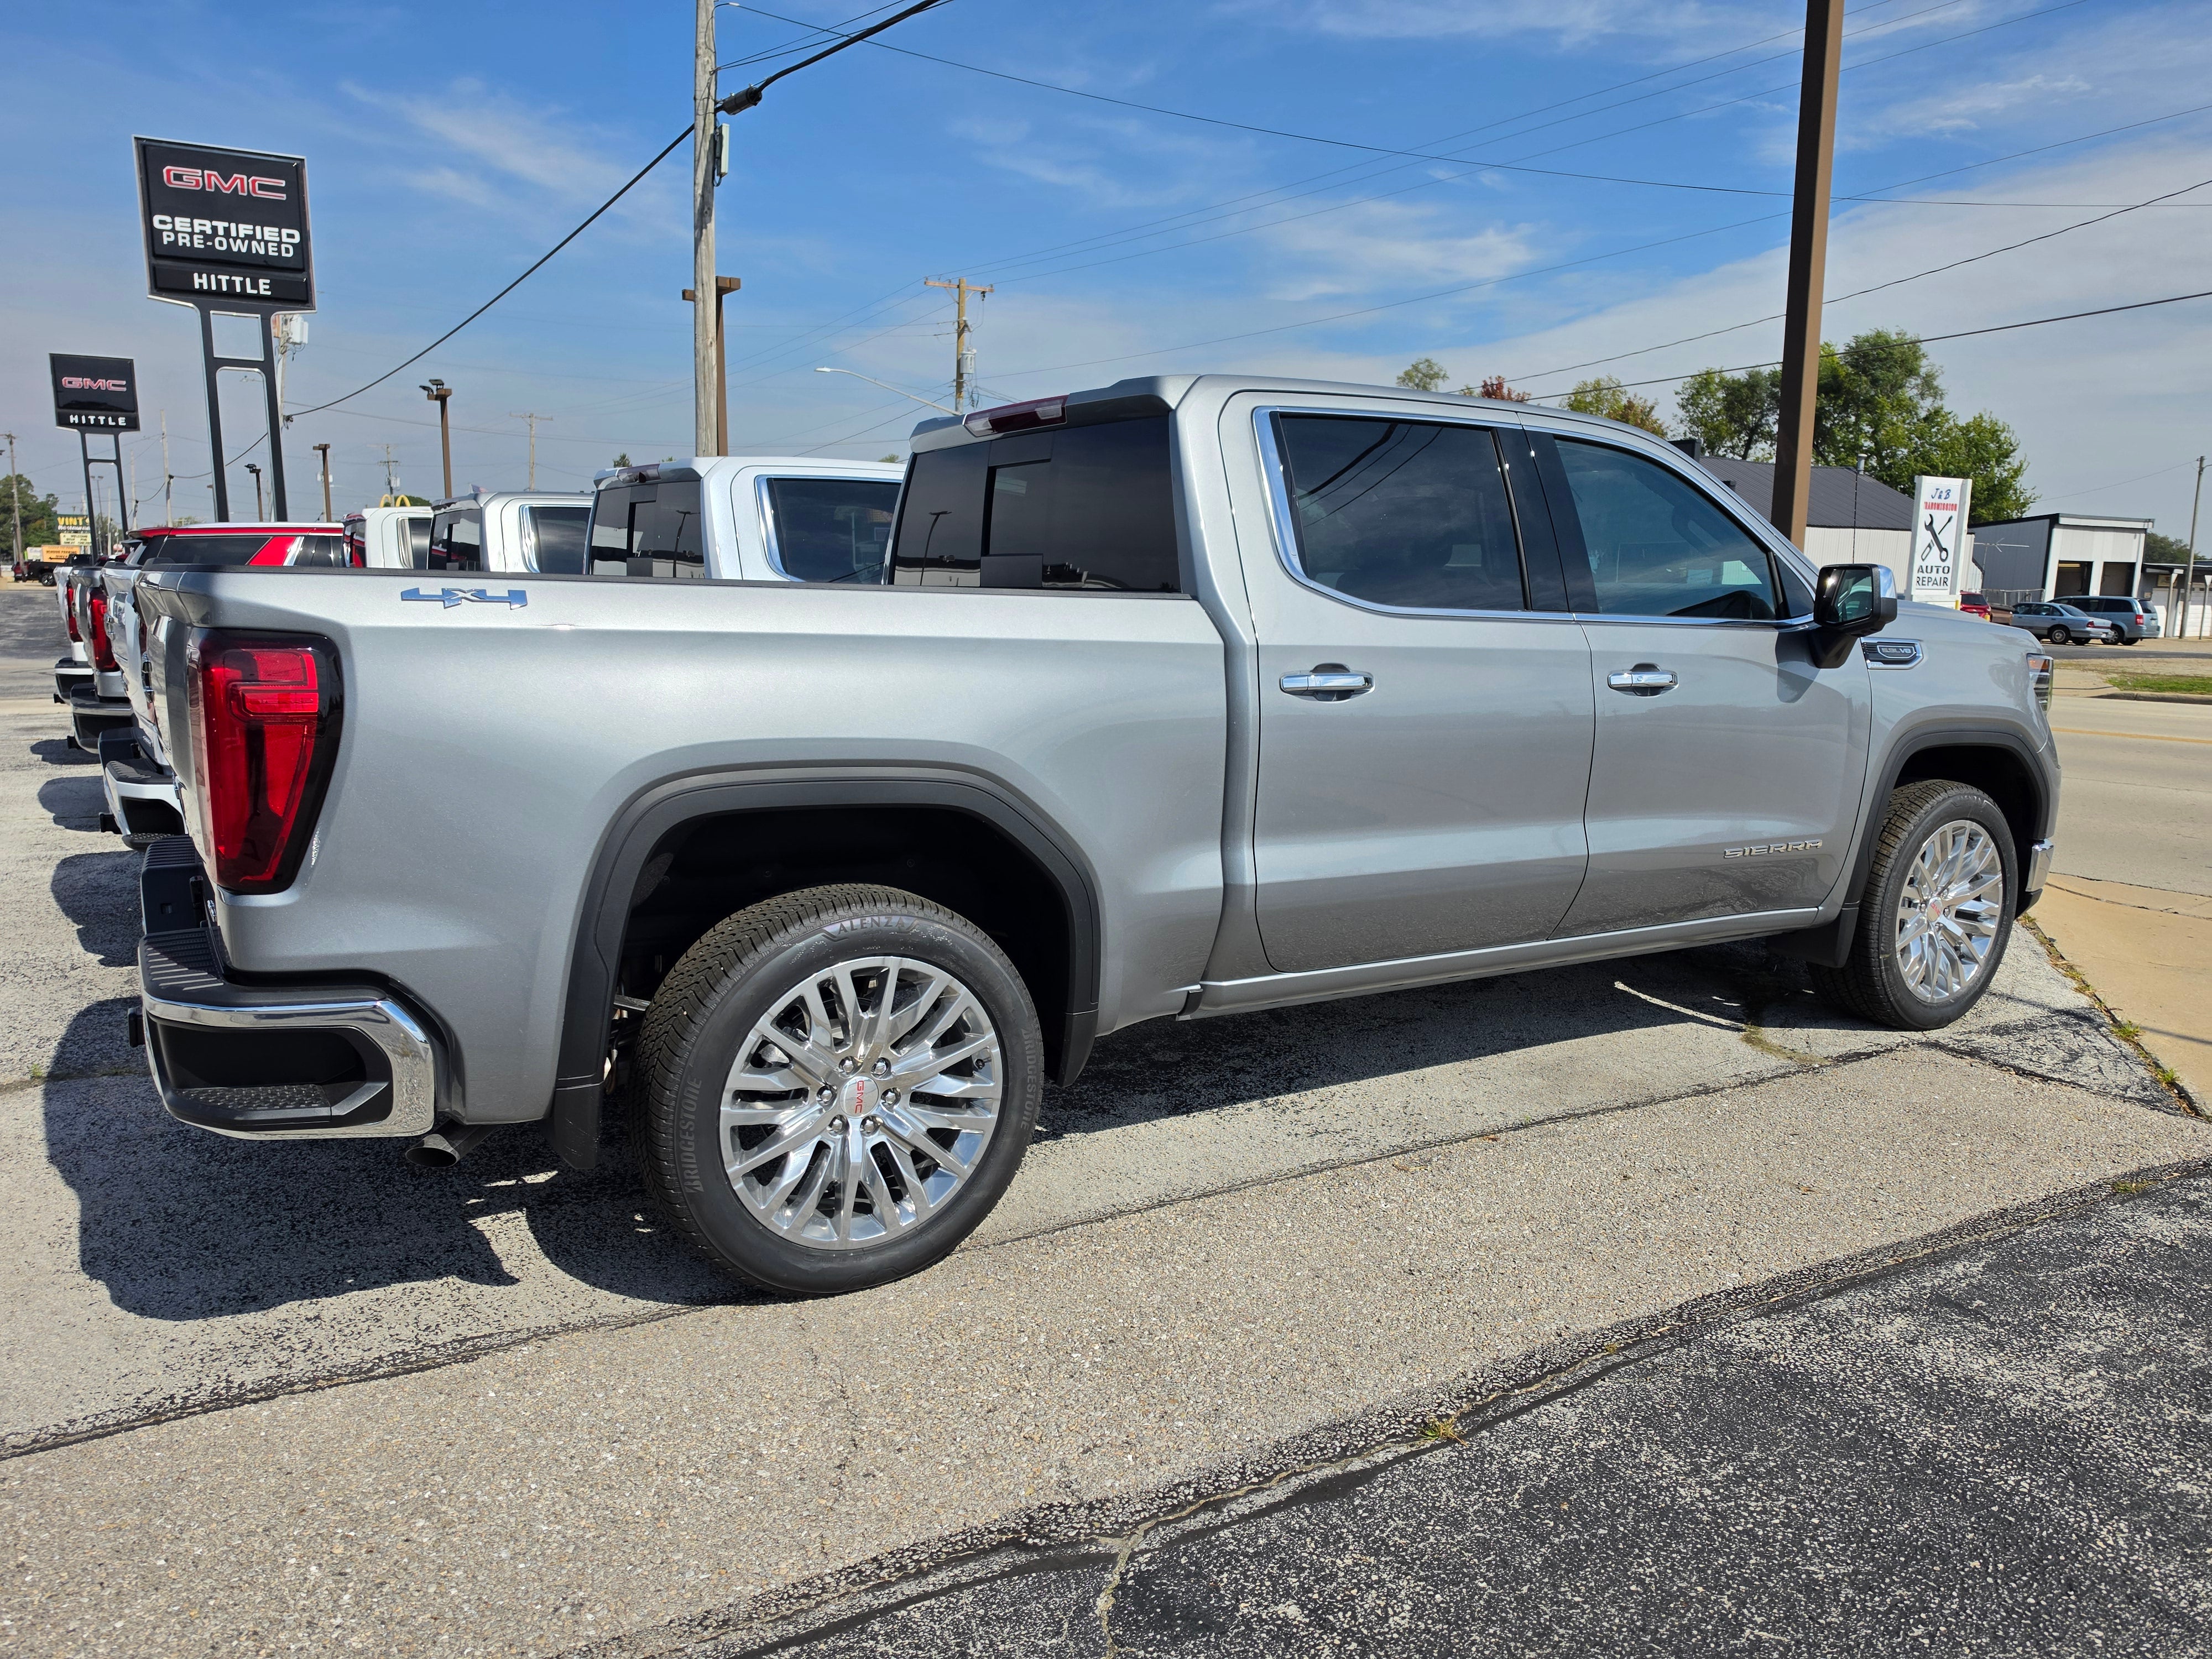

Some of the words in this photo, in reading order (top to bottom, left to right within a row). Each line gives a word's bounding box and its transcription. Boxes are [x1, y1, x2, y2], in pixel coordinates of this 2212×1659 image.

[163, 165, 286, 200] GMC
[153, 214, 301, 243] CERTIFIED
[162, 231, 294, 258] PRE-OWNED
[193, 273, 272, 295] HITTLE
[61, 377, 127, 392] GMC
[69, 414, 127, 426] HITTLE
[1917, 565, 1950, 574] AUTO
[1916, 576, 1949, 586] REPAIR
[1723, 839, 1823, 858] SIERRA
[838, 916, 905, 935] ALENZA
[1021, 1026, 1037, 1130] BRIDGESTONE
[855, 1080, 864, 1114] GMC
[679, 1078, 705, 1193] BRIDGESTONE
